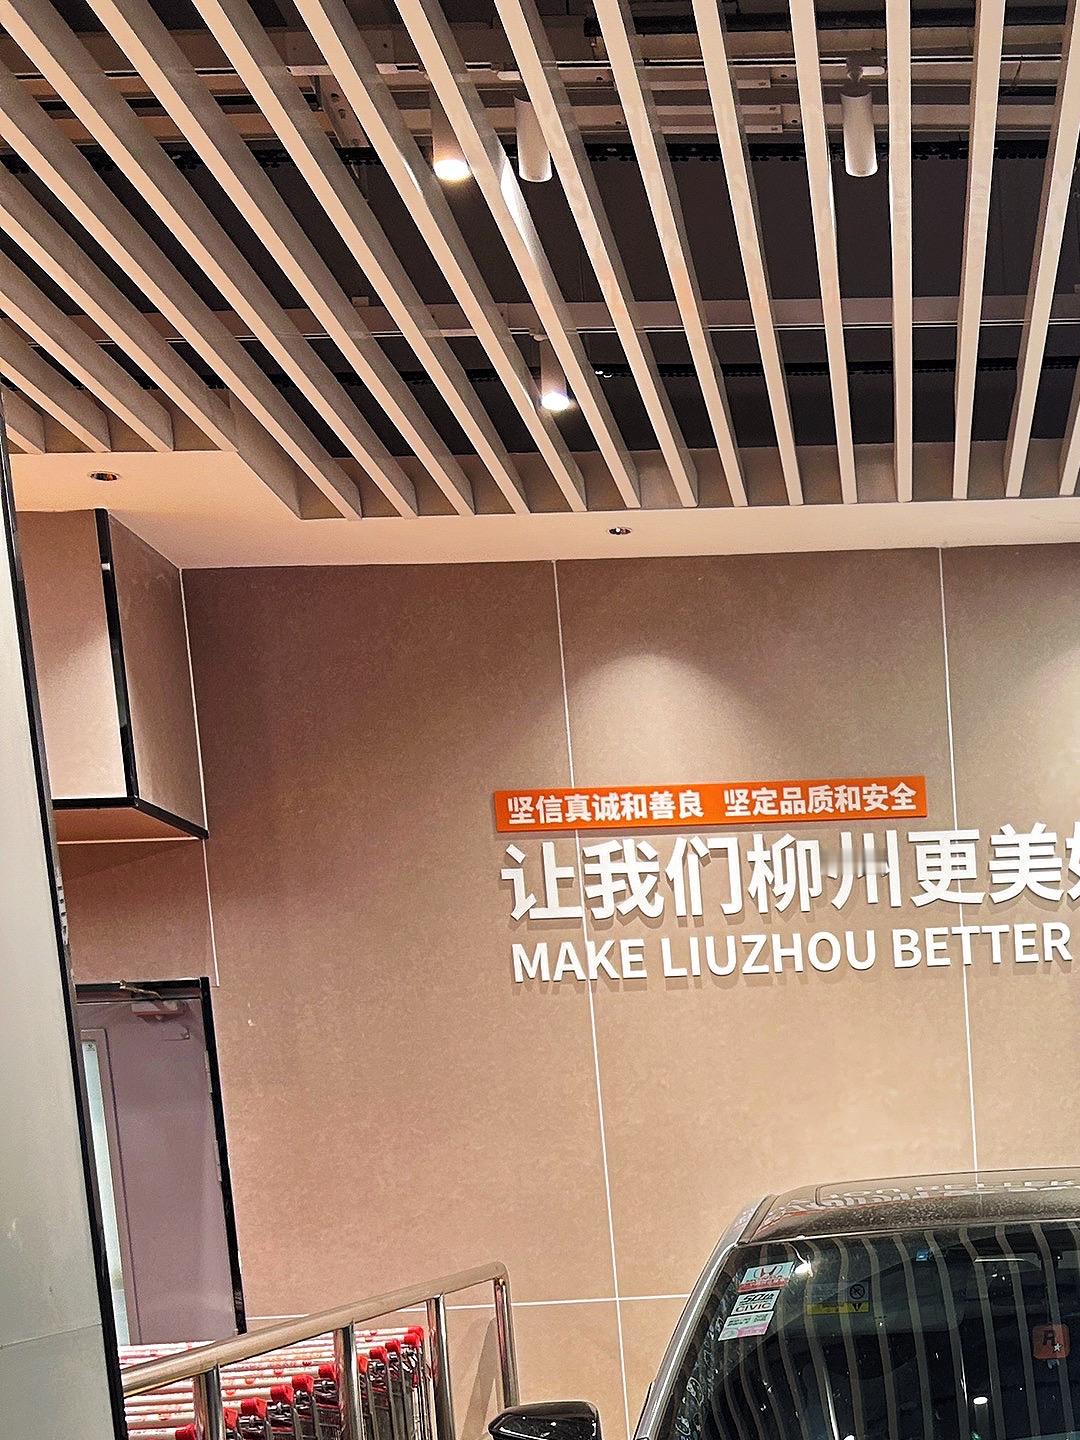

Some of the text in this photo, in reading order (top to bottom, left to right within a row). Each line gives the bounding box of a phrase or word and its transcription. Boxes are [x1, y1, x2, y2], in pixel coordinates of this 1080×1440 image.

[507, 781, 917, 825] 坚信真诚和善良 坚定品质和安全
[511, 920, 1073, 982] MAKE LIUZHOU BETTER
[736, 1303, 771, 1313] CIVIC
